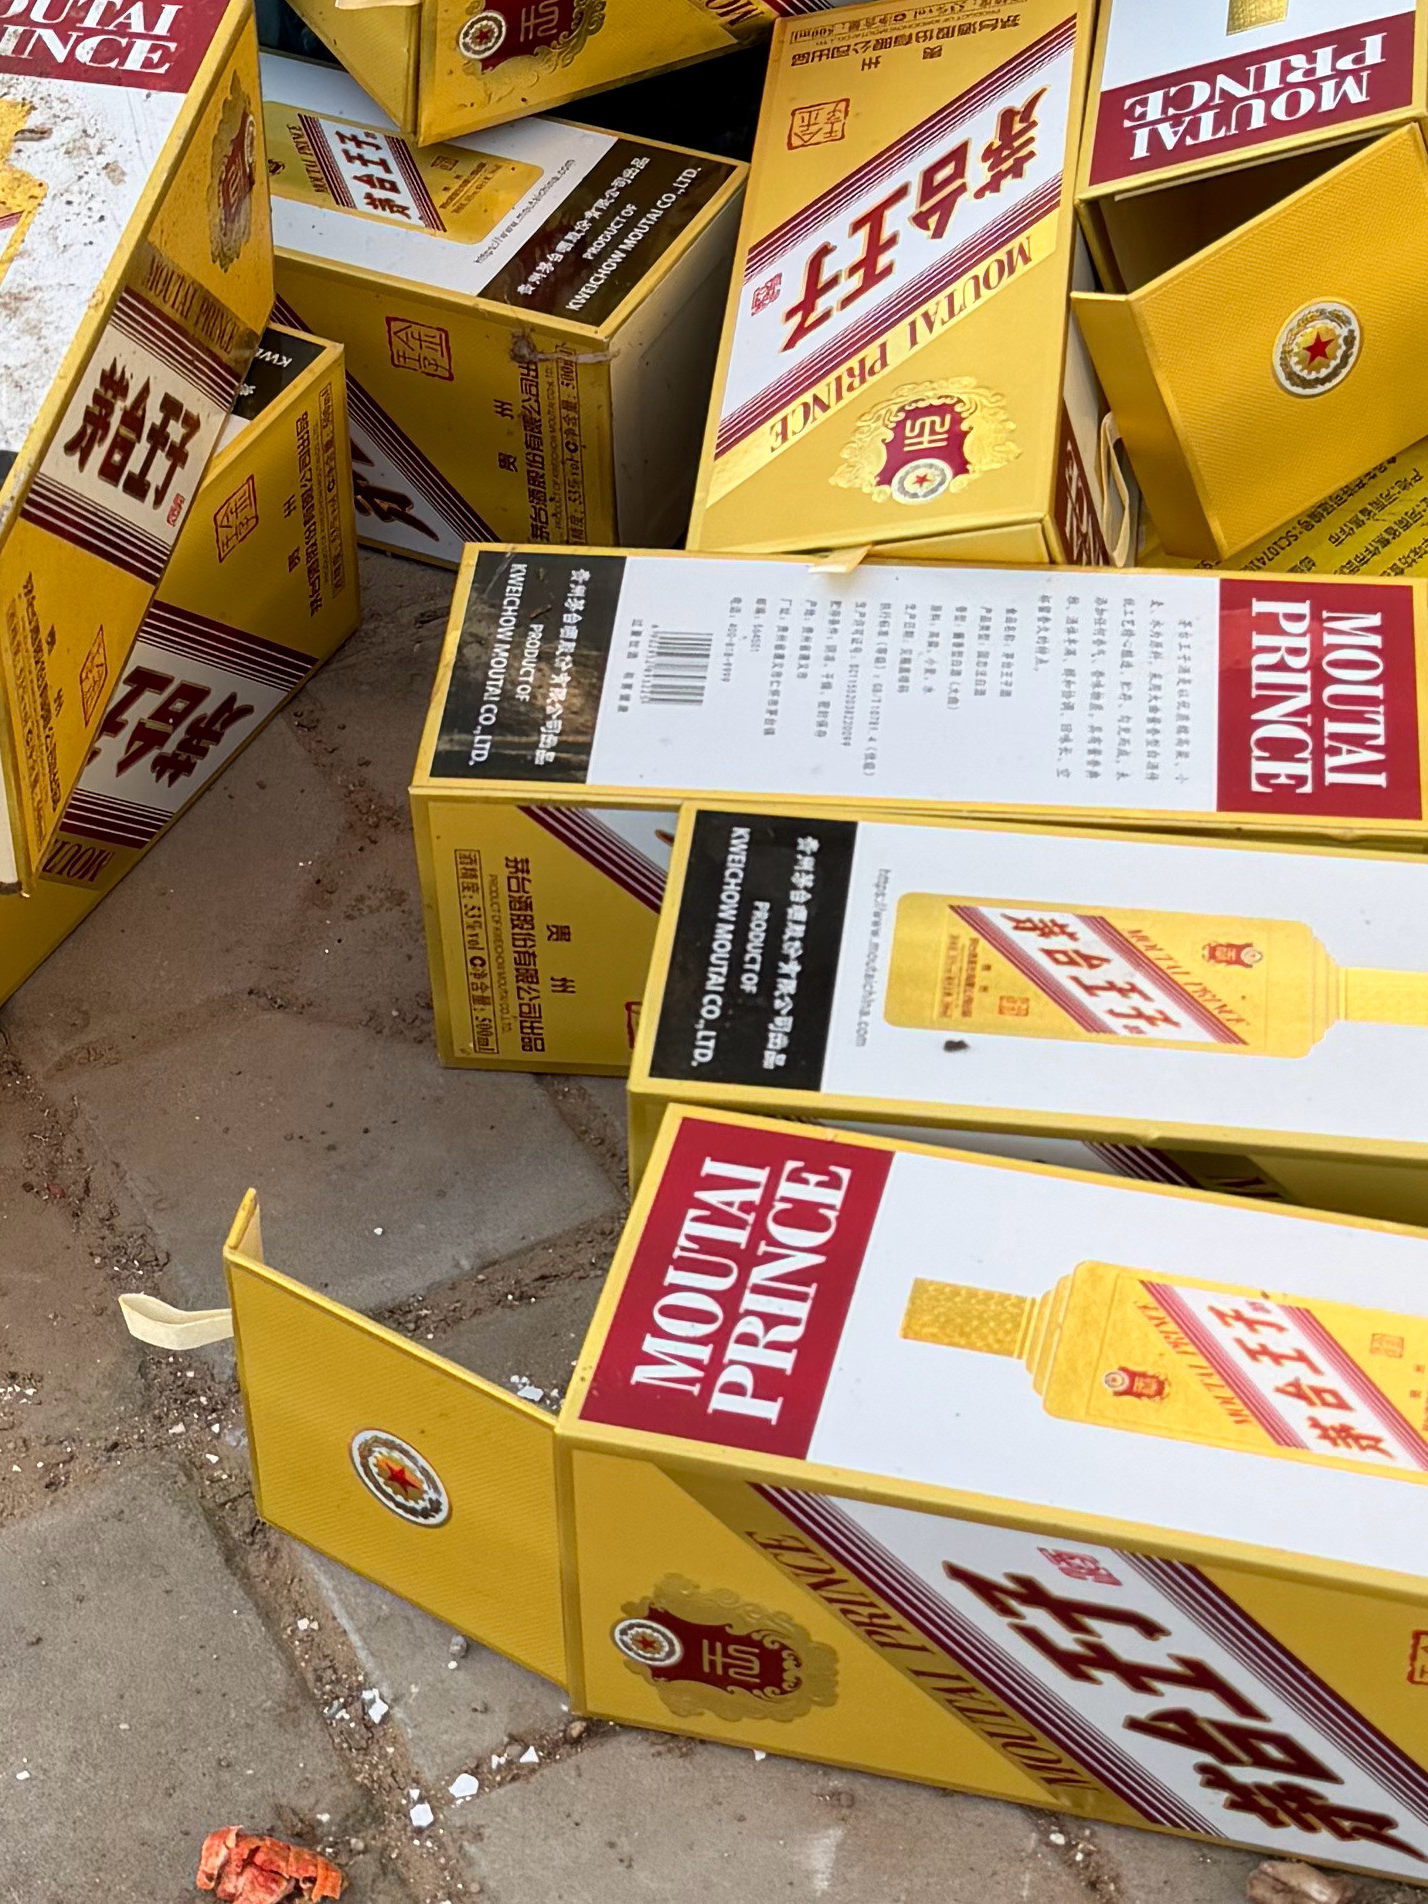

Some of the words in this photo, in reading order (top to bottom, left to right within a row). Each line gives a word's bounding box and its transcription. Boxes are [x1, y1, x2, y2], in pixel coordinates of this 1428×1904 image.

[790, 14, 1021, 67] 茅台酒股份有限公司出品
[1123, 32, 1388, 128] PRINCE
[1129, 70, 1371, 161] MOUTAI
[335, 130, 412, 219] 茅台王子
[782, 87, 1047, 352] 茅台王子
[565, 249, 627, 311] KWEICHOW
[618, 208, 664, 252] MOUTAI
[582, 218, 627, 260] PRODUCT
[620, 203, 638, 217] OF
[141, 254, 196, 332] MOUTAI
[192, 294, 237, 355] PRINCE
[908, 235, 1033, 350] MOUTAI
[61, 350, 198, 496] 茅台王子
[769, 330, 890, 445] PRINCE
[495, 563, 528, 642] KWEICHOW
[515, 622, 545, 684] PRODUCT
[483, 643, 511, 701] MOUTAI
[511, 682, 532, 703] OF
[1250, 597, 1313, 794] PRINCE
[1321, 610, 1387, 788] MOUTAI
[713, 824, 752, 921] KWEICHOW
[503, 854, 545, 1052] 茅台酒股份有限公司出品
[702, 921, 737, 992] MOUTAI
[736, 970, 760, 994] OF
[741, 899, 771, 972] PRODUCT
[855, 868, 892, 1048] https://www.moutaichina.com
[630, 1156, 771, 1396] MOUTAI
[707, 1160, 852, 1426] PRINCE
[744, 1530, 936, 1655] PRINCE
[911, 1669, 1101, 1791] MOUTAI
[940, 1558, 1422, 1856] 茅台王子
